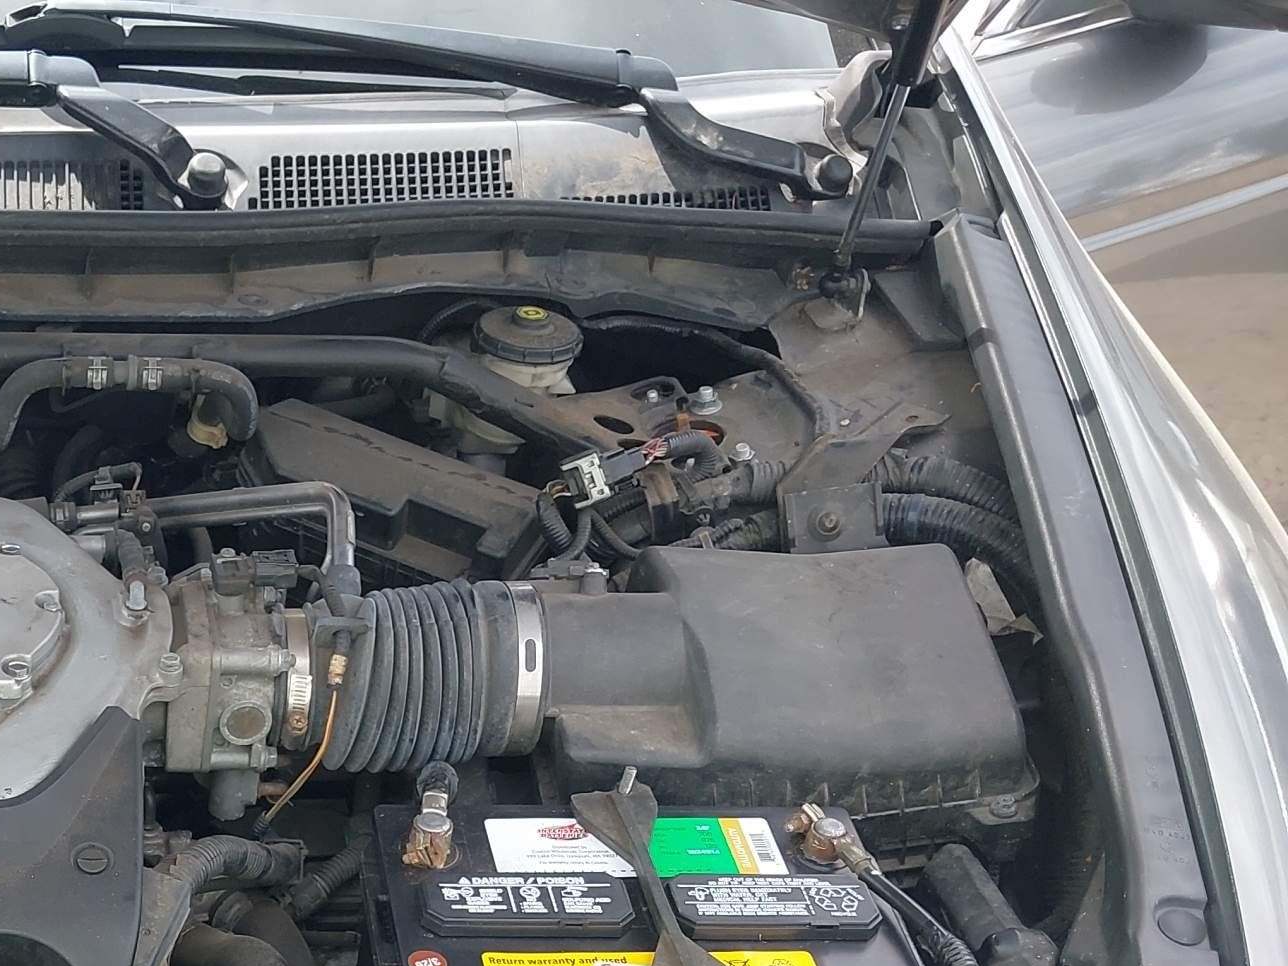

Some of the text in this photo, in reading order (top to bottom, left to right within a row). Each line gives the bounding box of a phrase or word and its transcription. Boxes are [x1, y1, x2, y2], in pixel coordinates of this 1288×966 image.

[472, 877, 524, 885] DANGER
[538, 877, 585, 885] POISON
[488, 956, 525, 965] Return
[527, 957, 575, 966] warranty
[578, 956, 598, 965] and
